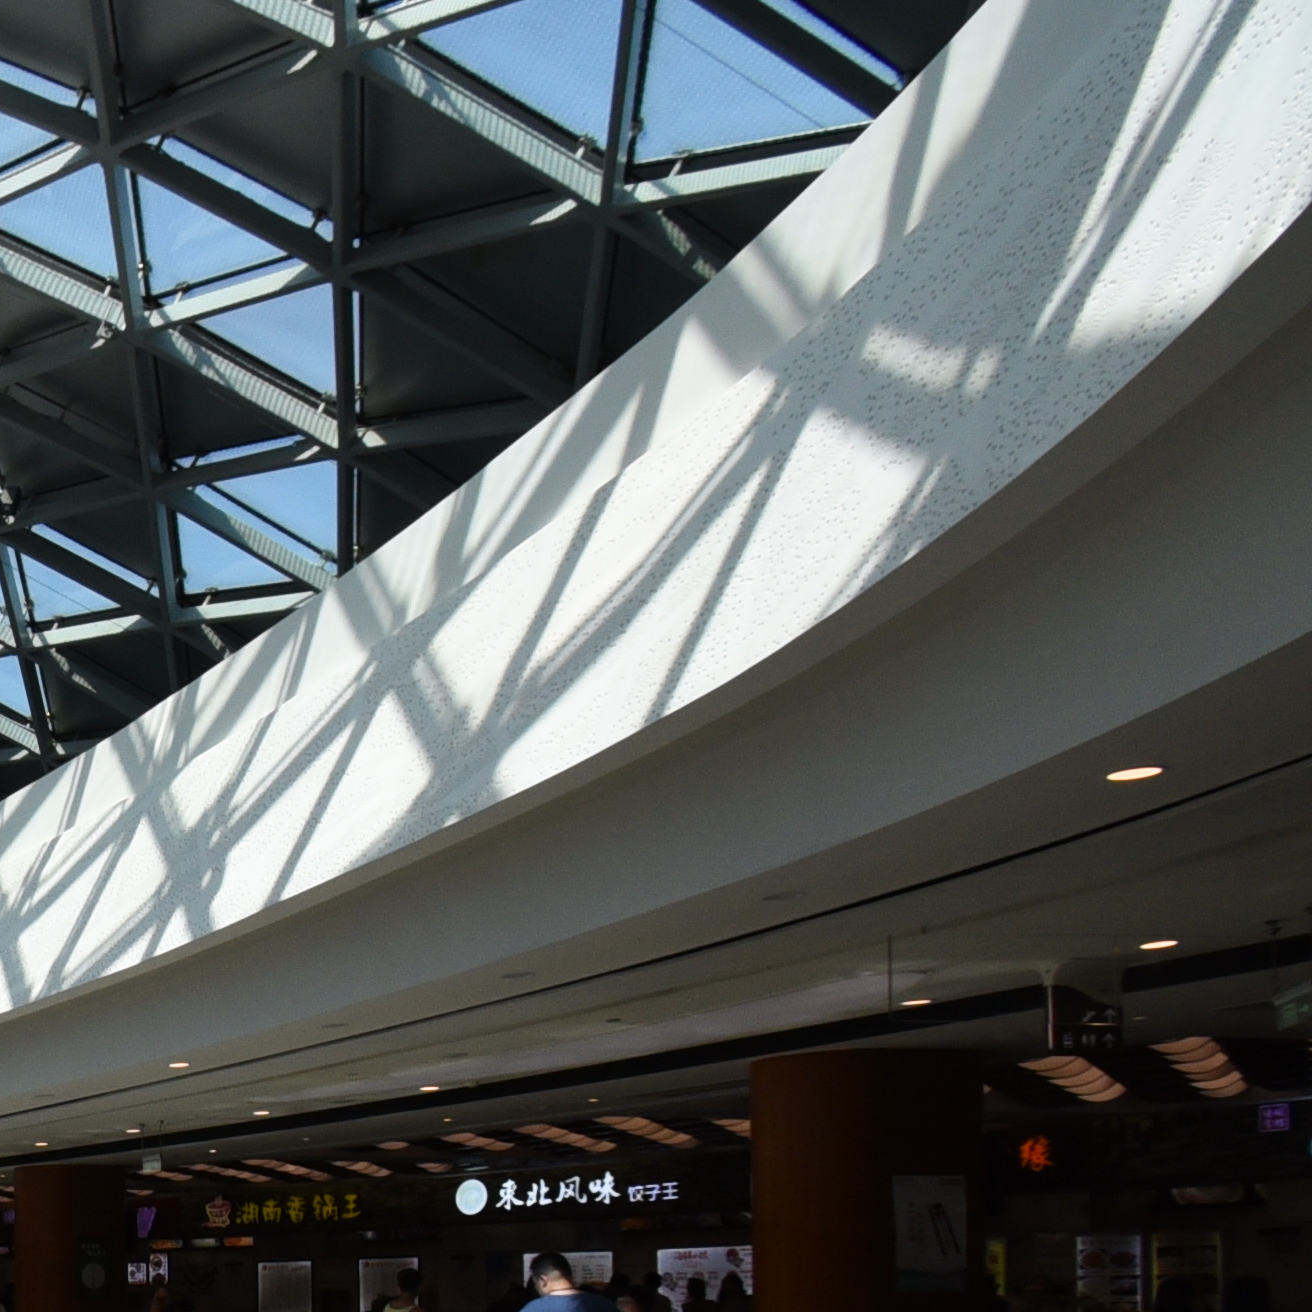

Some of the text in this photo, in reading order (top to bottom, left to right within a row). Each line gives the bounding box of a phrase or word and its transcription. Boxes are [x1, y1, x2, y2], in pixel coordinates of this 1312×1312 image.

[628, 1181, 679, 1203] 饺子王
[235, 1192, 362, 1226] 湖南香锅王
